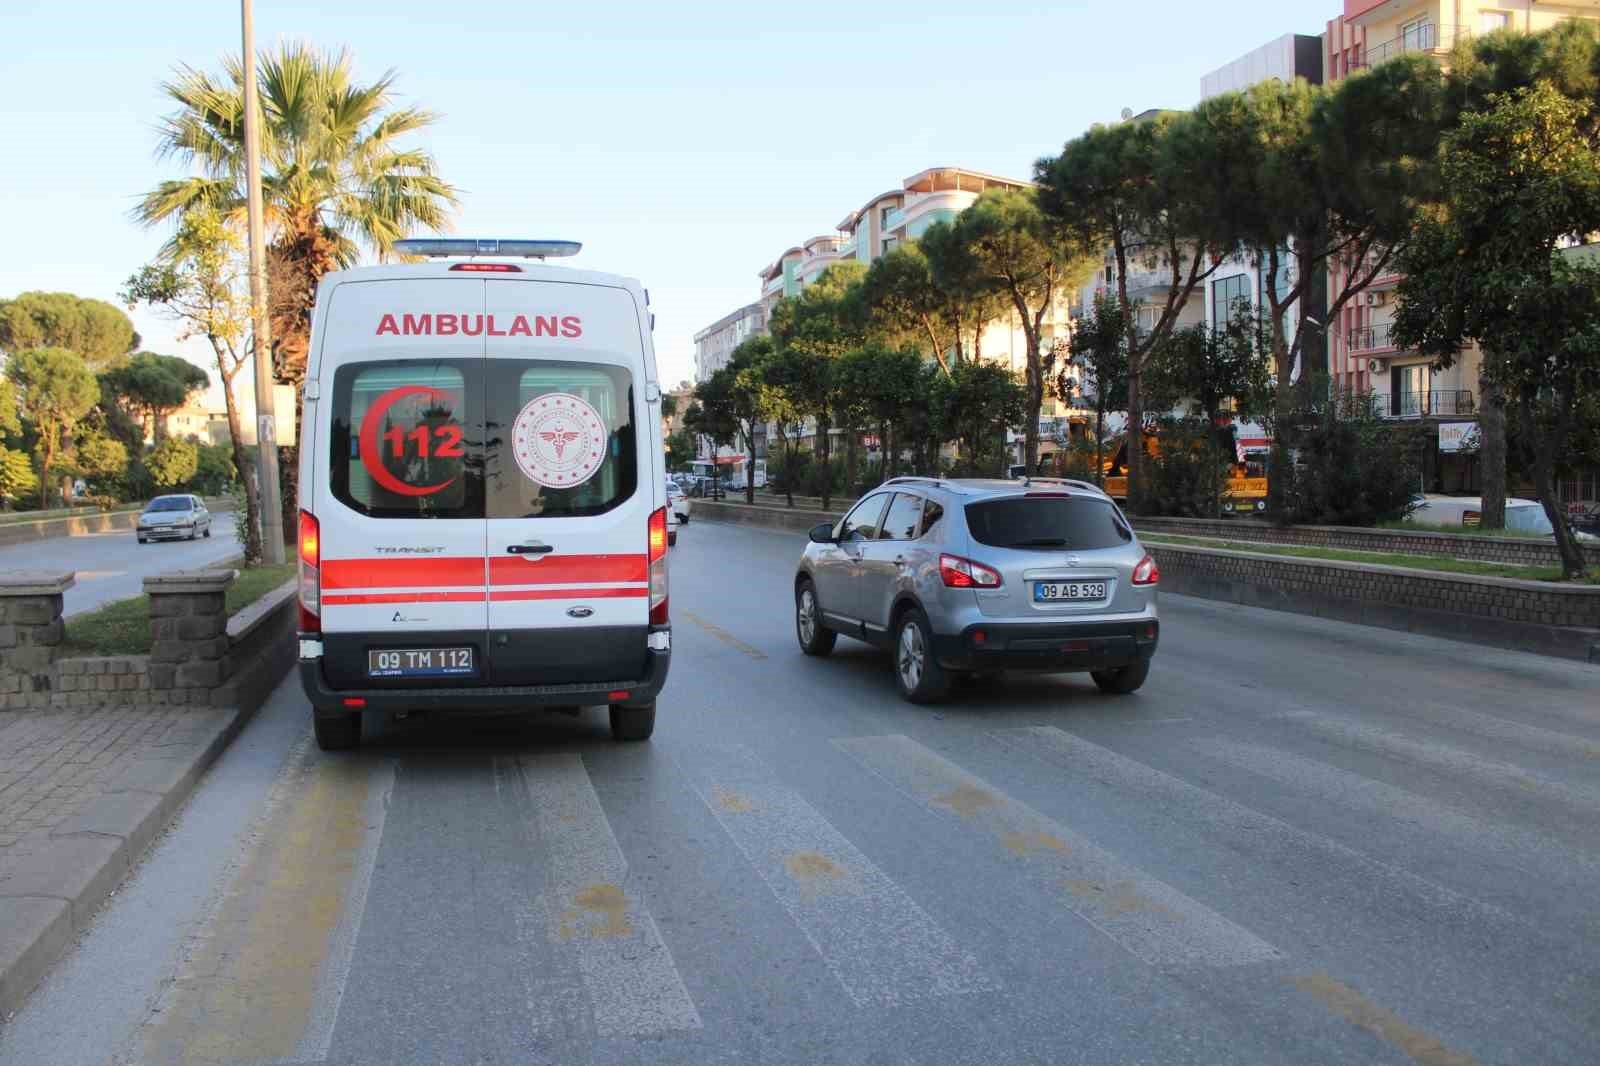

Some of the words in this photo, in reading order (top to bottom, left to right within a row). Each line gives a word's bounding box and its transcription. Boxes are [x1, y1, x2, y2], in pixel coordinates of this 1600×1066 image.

[375, 313, 583, 338] AMBULANS
[384, 424, 464, 457] 112
[1042, 585, 1057, 597] 09
[1062, 585, 1078, 597] AB
[1083, 584, 1104, 597] 529
[378, 652, 400, 669] 09
[405, 651, 431, 668] TM
[439, 650, 469, 668] 112
